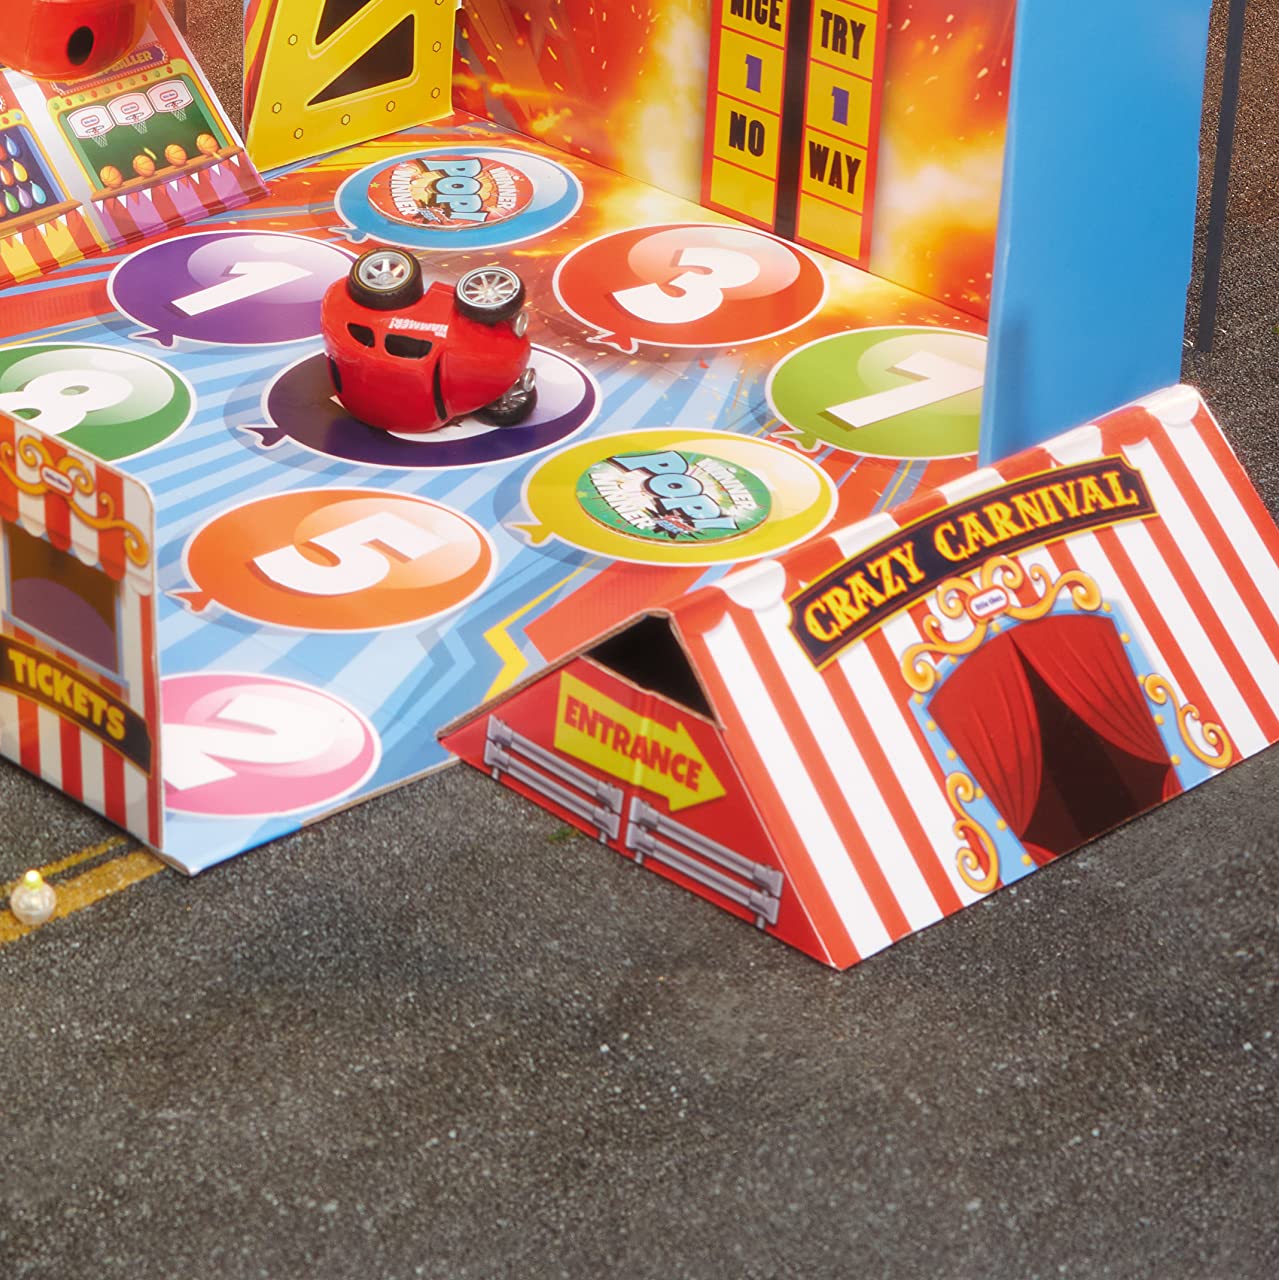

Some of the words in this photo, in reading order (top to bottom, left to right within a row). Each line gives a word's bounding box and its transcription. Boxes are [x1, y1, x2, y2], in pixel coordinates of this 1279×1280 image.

[745, 53, 763, 94] 1
[820, 8, 866, 60] TRY
[831, 85, 850, 127] 1
[419, 158, 489, 222] POP!
[728, 110, 765, 157] NO
[808, 140, 862, 195] WAY
[171, 261, 314, 317] 1
[612, 247, 761, 324] 3
[609, 450, 740, 530] POP!
[253, 511, 450, 595] 5
[804, 540, 925, 642] CRAZY
[933, 470, 1139, 562] CARNIVAL
[8, 648, 125, 740] TICKETS
[162, 694, 335, 791] 2
[564, 695, 703, 792] ENTRANCE
